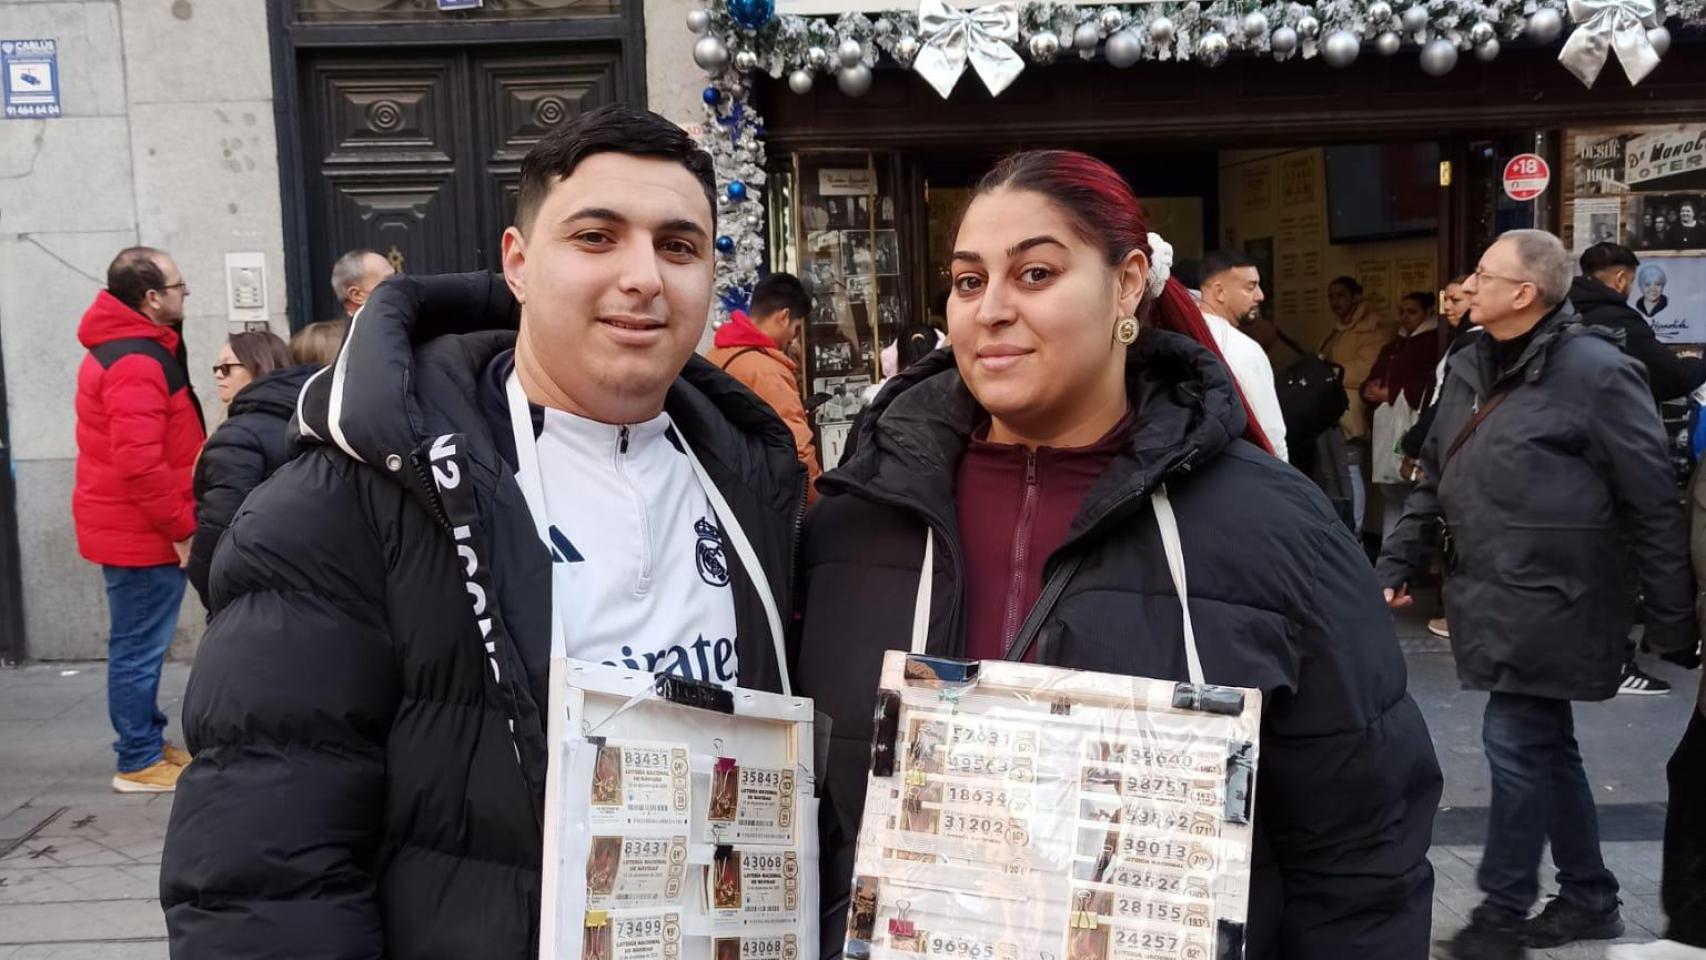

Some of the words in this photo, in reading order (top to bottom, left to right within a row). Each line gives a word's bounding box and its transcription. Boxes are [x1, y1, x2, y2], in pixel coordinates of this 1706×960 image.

[1511, 158, 1537, 174] +18
[624, 751, 668, 767] 83431
[742, 770, 779, 786] 35843
[949, 787, 1007, 805] 18634
[944, 814, 1003, 834] 31202
[624, 841, 668, 856] 83431
[1124, 838, 1186, 859] 39013
[743, 855, 782, 869] 43068
[1119, 899, 1181, 921] 28155
[617, 919, 661, 936] 73499
[742, 940, 781, 954] 43068
[933, 938, 993, 957] 96965
[1116, 931, 1178, 951] 24257
